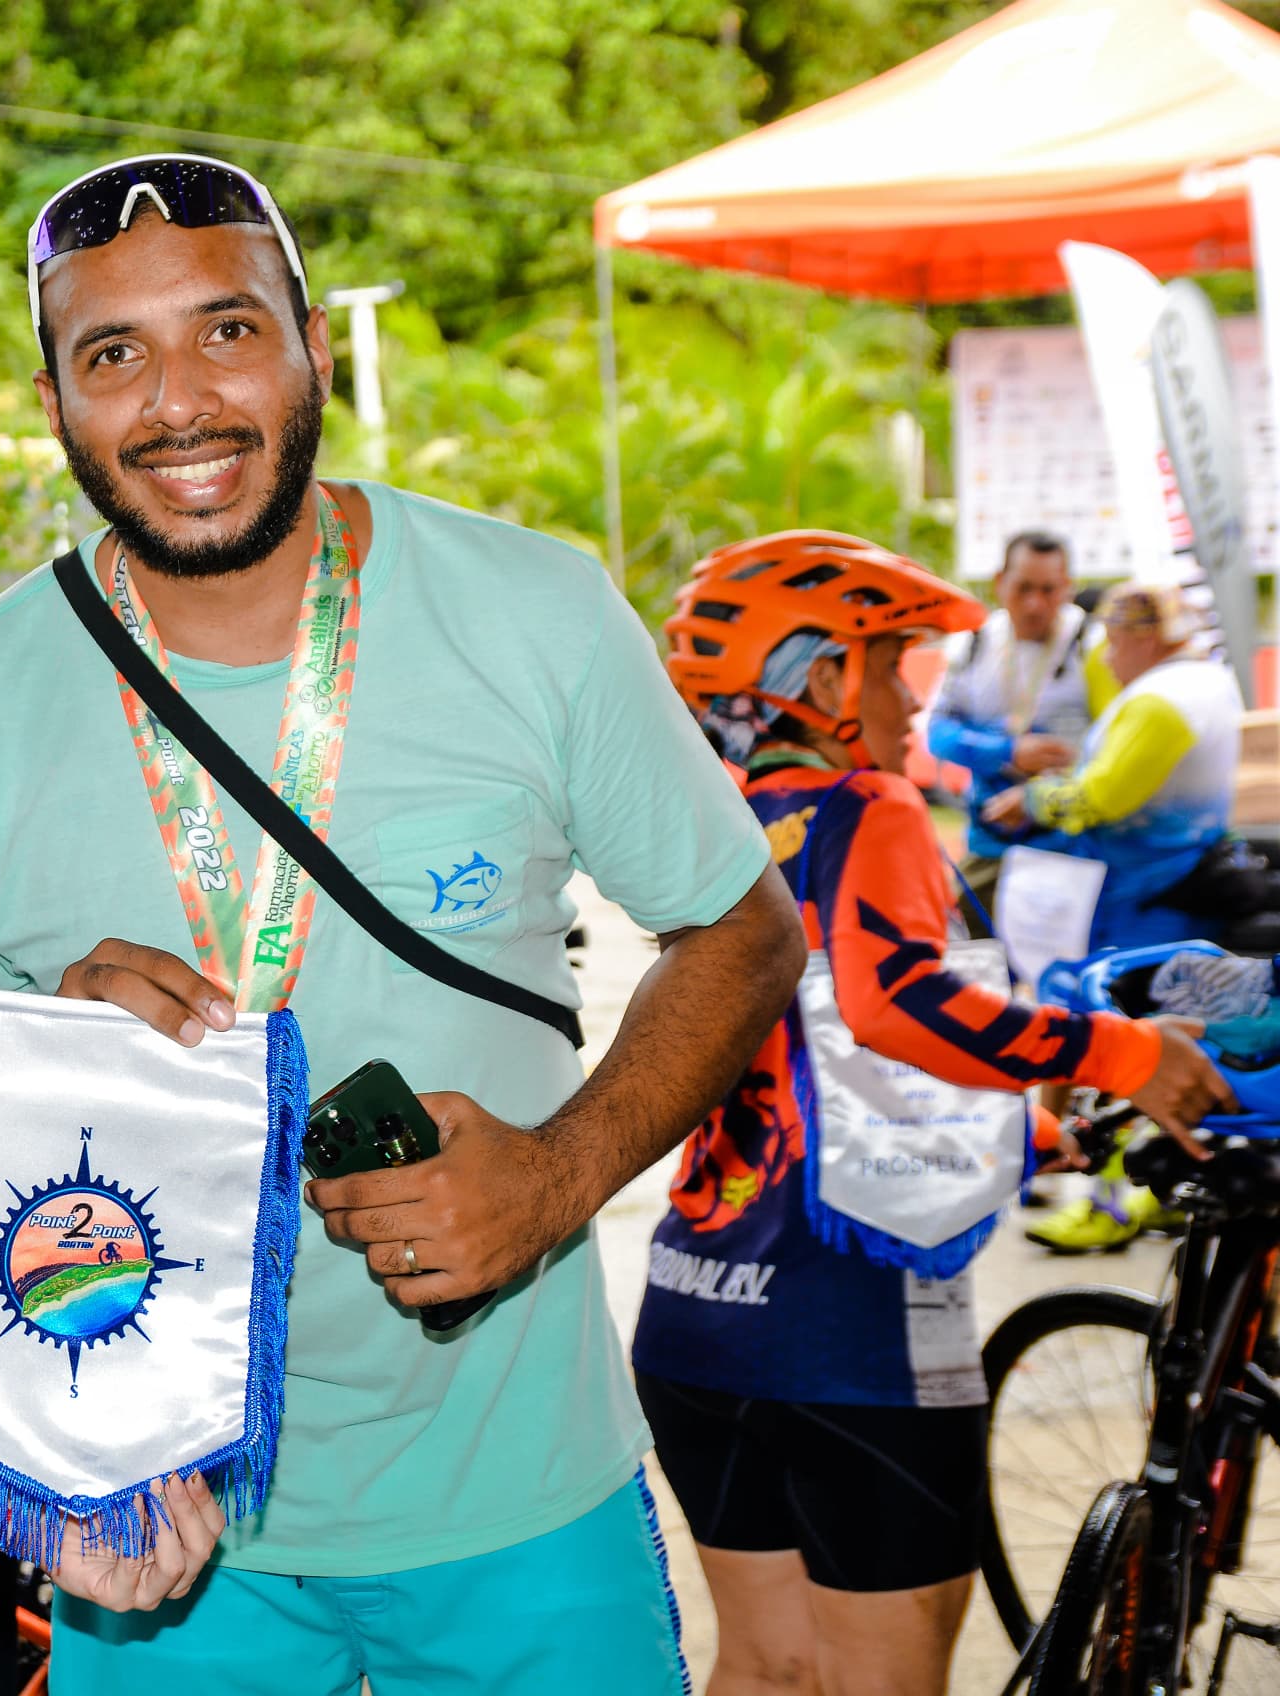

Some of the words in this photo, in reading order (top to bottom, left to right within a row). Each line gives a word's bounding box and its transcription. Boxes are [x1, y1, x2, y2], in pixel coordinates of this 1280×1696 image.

[305, 594, 332, 674] Análisis
[281, 728, 305, 801] CLÍNICAS
[302, 730, 326, 794] Ahorro
[178, 805, 228, 892] 2022
[265, 849, 290, 923] Farmacias
[281, 863, 300, 916] Ahorro
[253, 921, 294, 970] FA
[80, 1127, 93, 1141] N
[62, 1202, 94, 1239] 2
[194, 1258, 205, 1272] E
[70, 1384, 79, 1399] S
